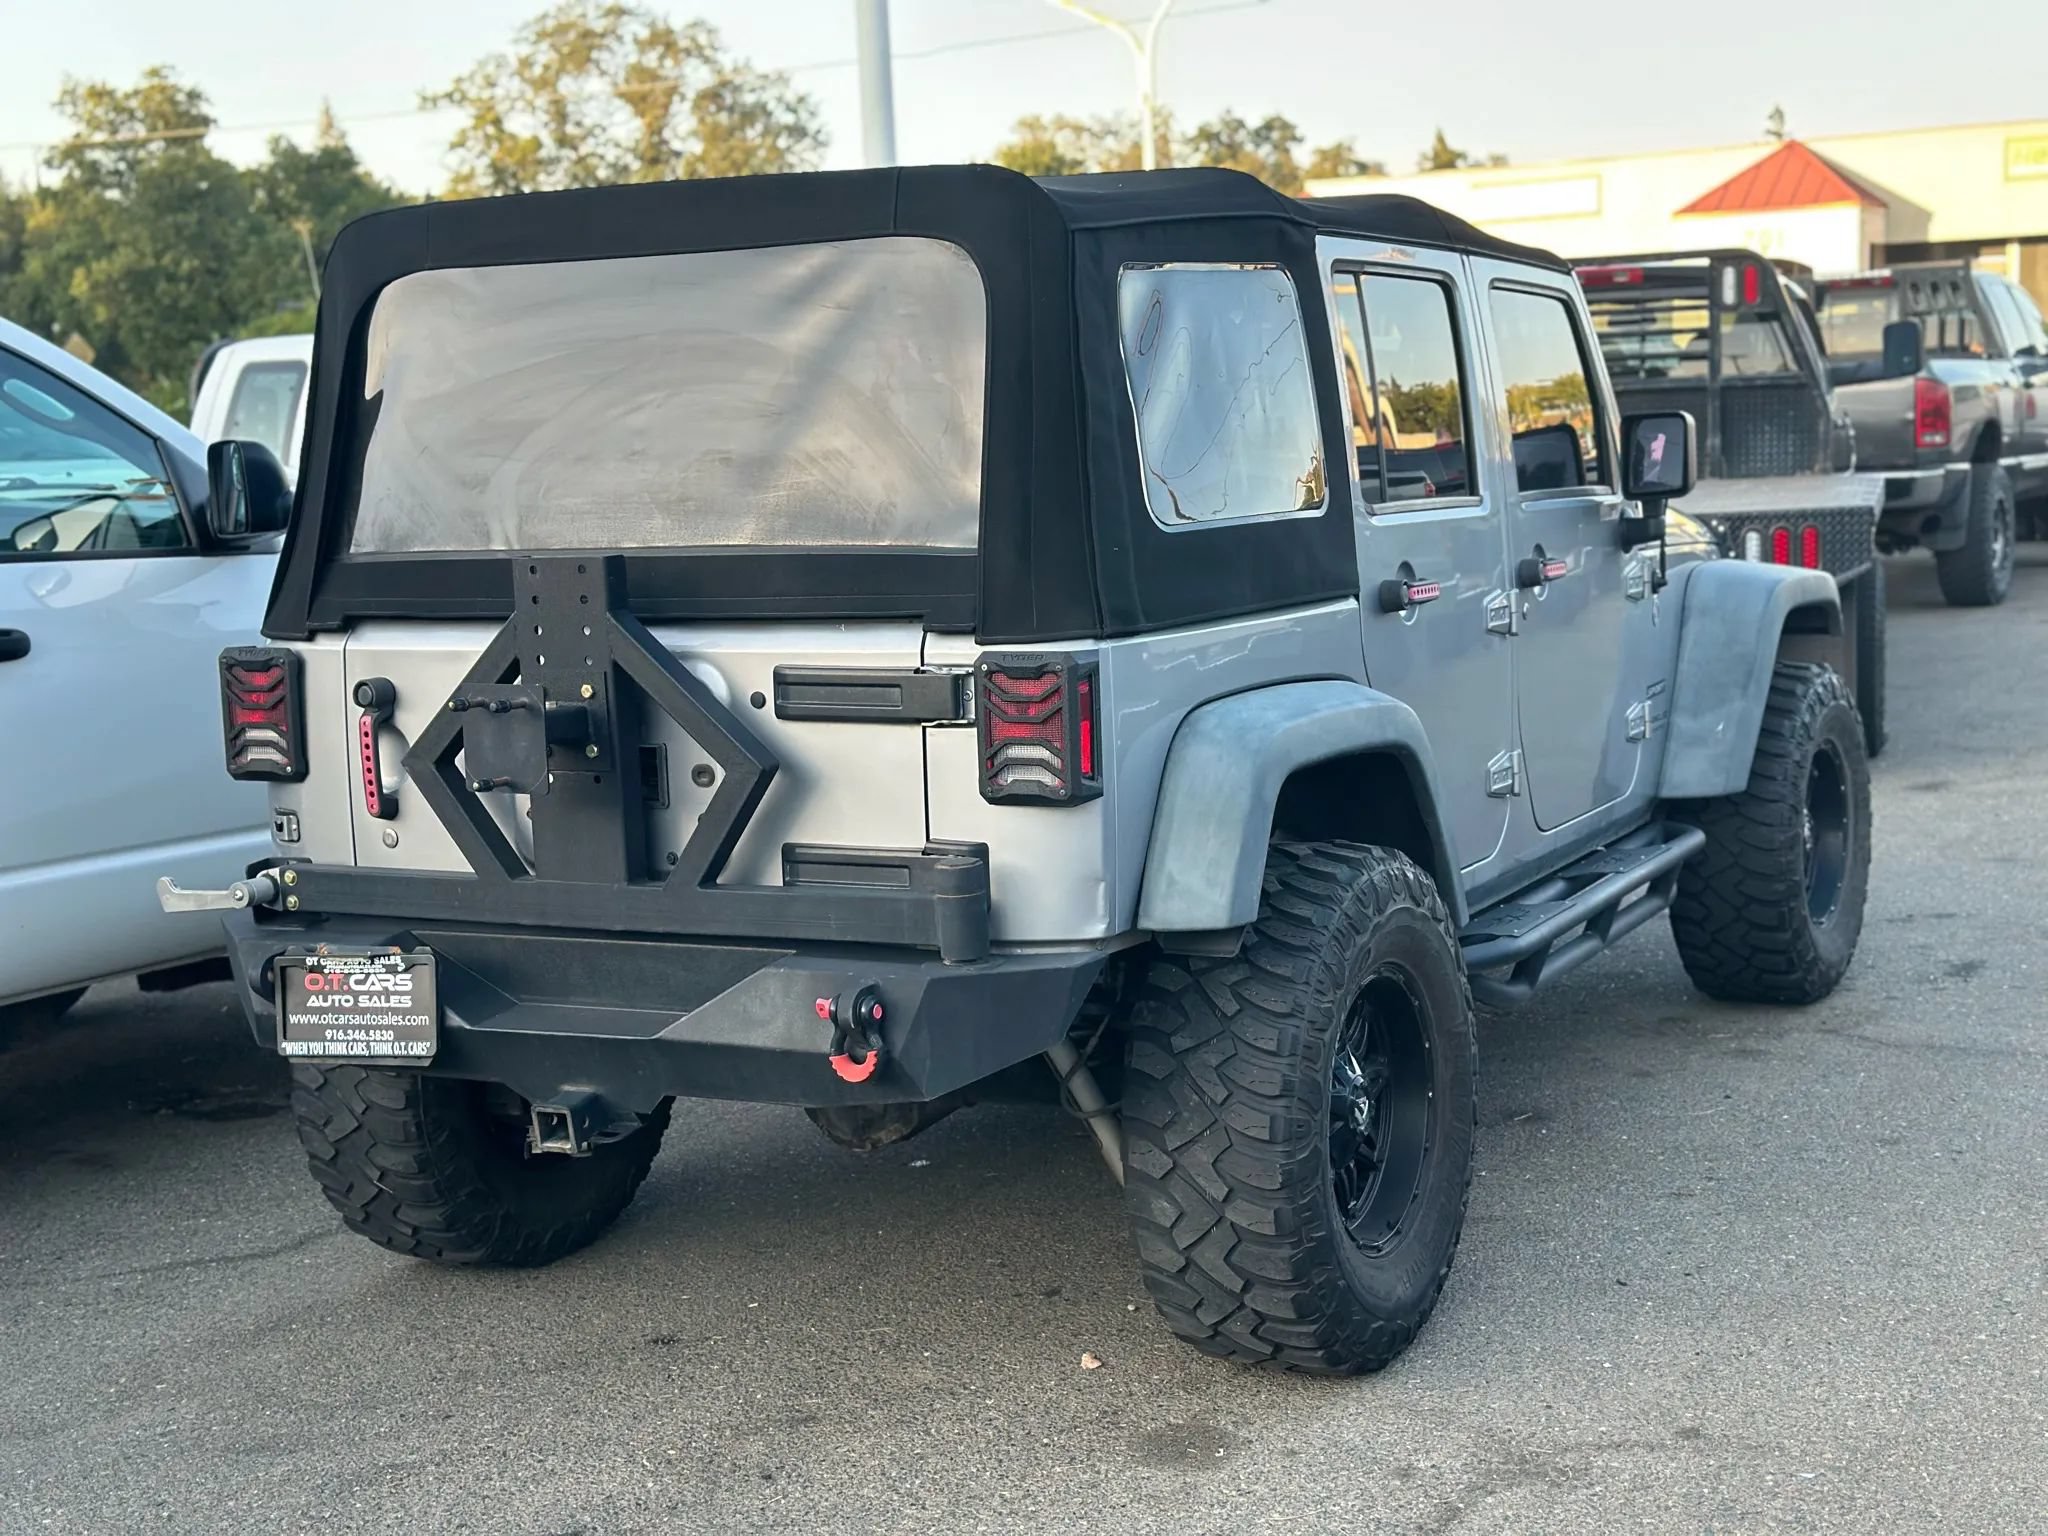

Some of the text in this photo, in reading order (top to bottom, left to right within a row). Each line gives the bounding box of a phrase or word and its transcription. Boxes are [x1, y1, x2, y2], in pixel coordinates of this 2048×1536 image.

[373, 955, 402, 965] SALES
[306, 994, 412, 1008] AUTO SALES
[289, 1011, 430, 1026] www.otcarsautosales.com
[324, 1029, 394, 1041] 916.346.5830
[308, 1041, 324, 1055] YOU
[324, 1041, 347, 1055] THINK
[347, 1041, 369, 1056] CARS,
[370, 1041, 392, 1055] THINK
[393, 1041, 407, 1055] O.T.
